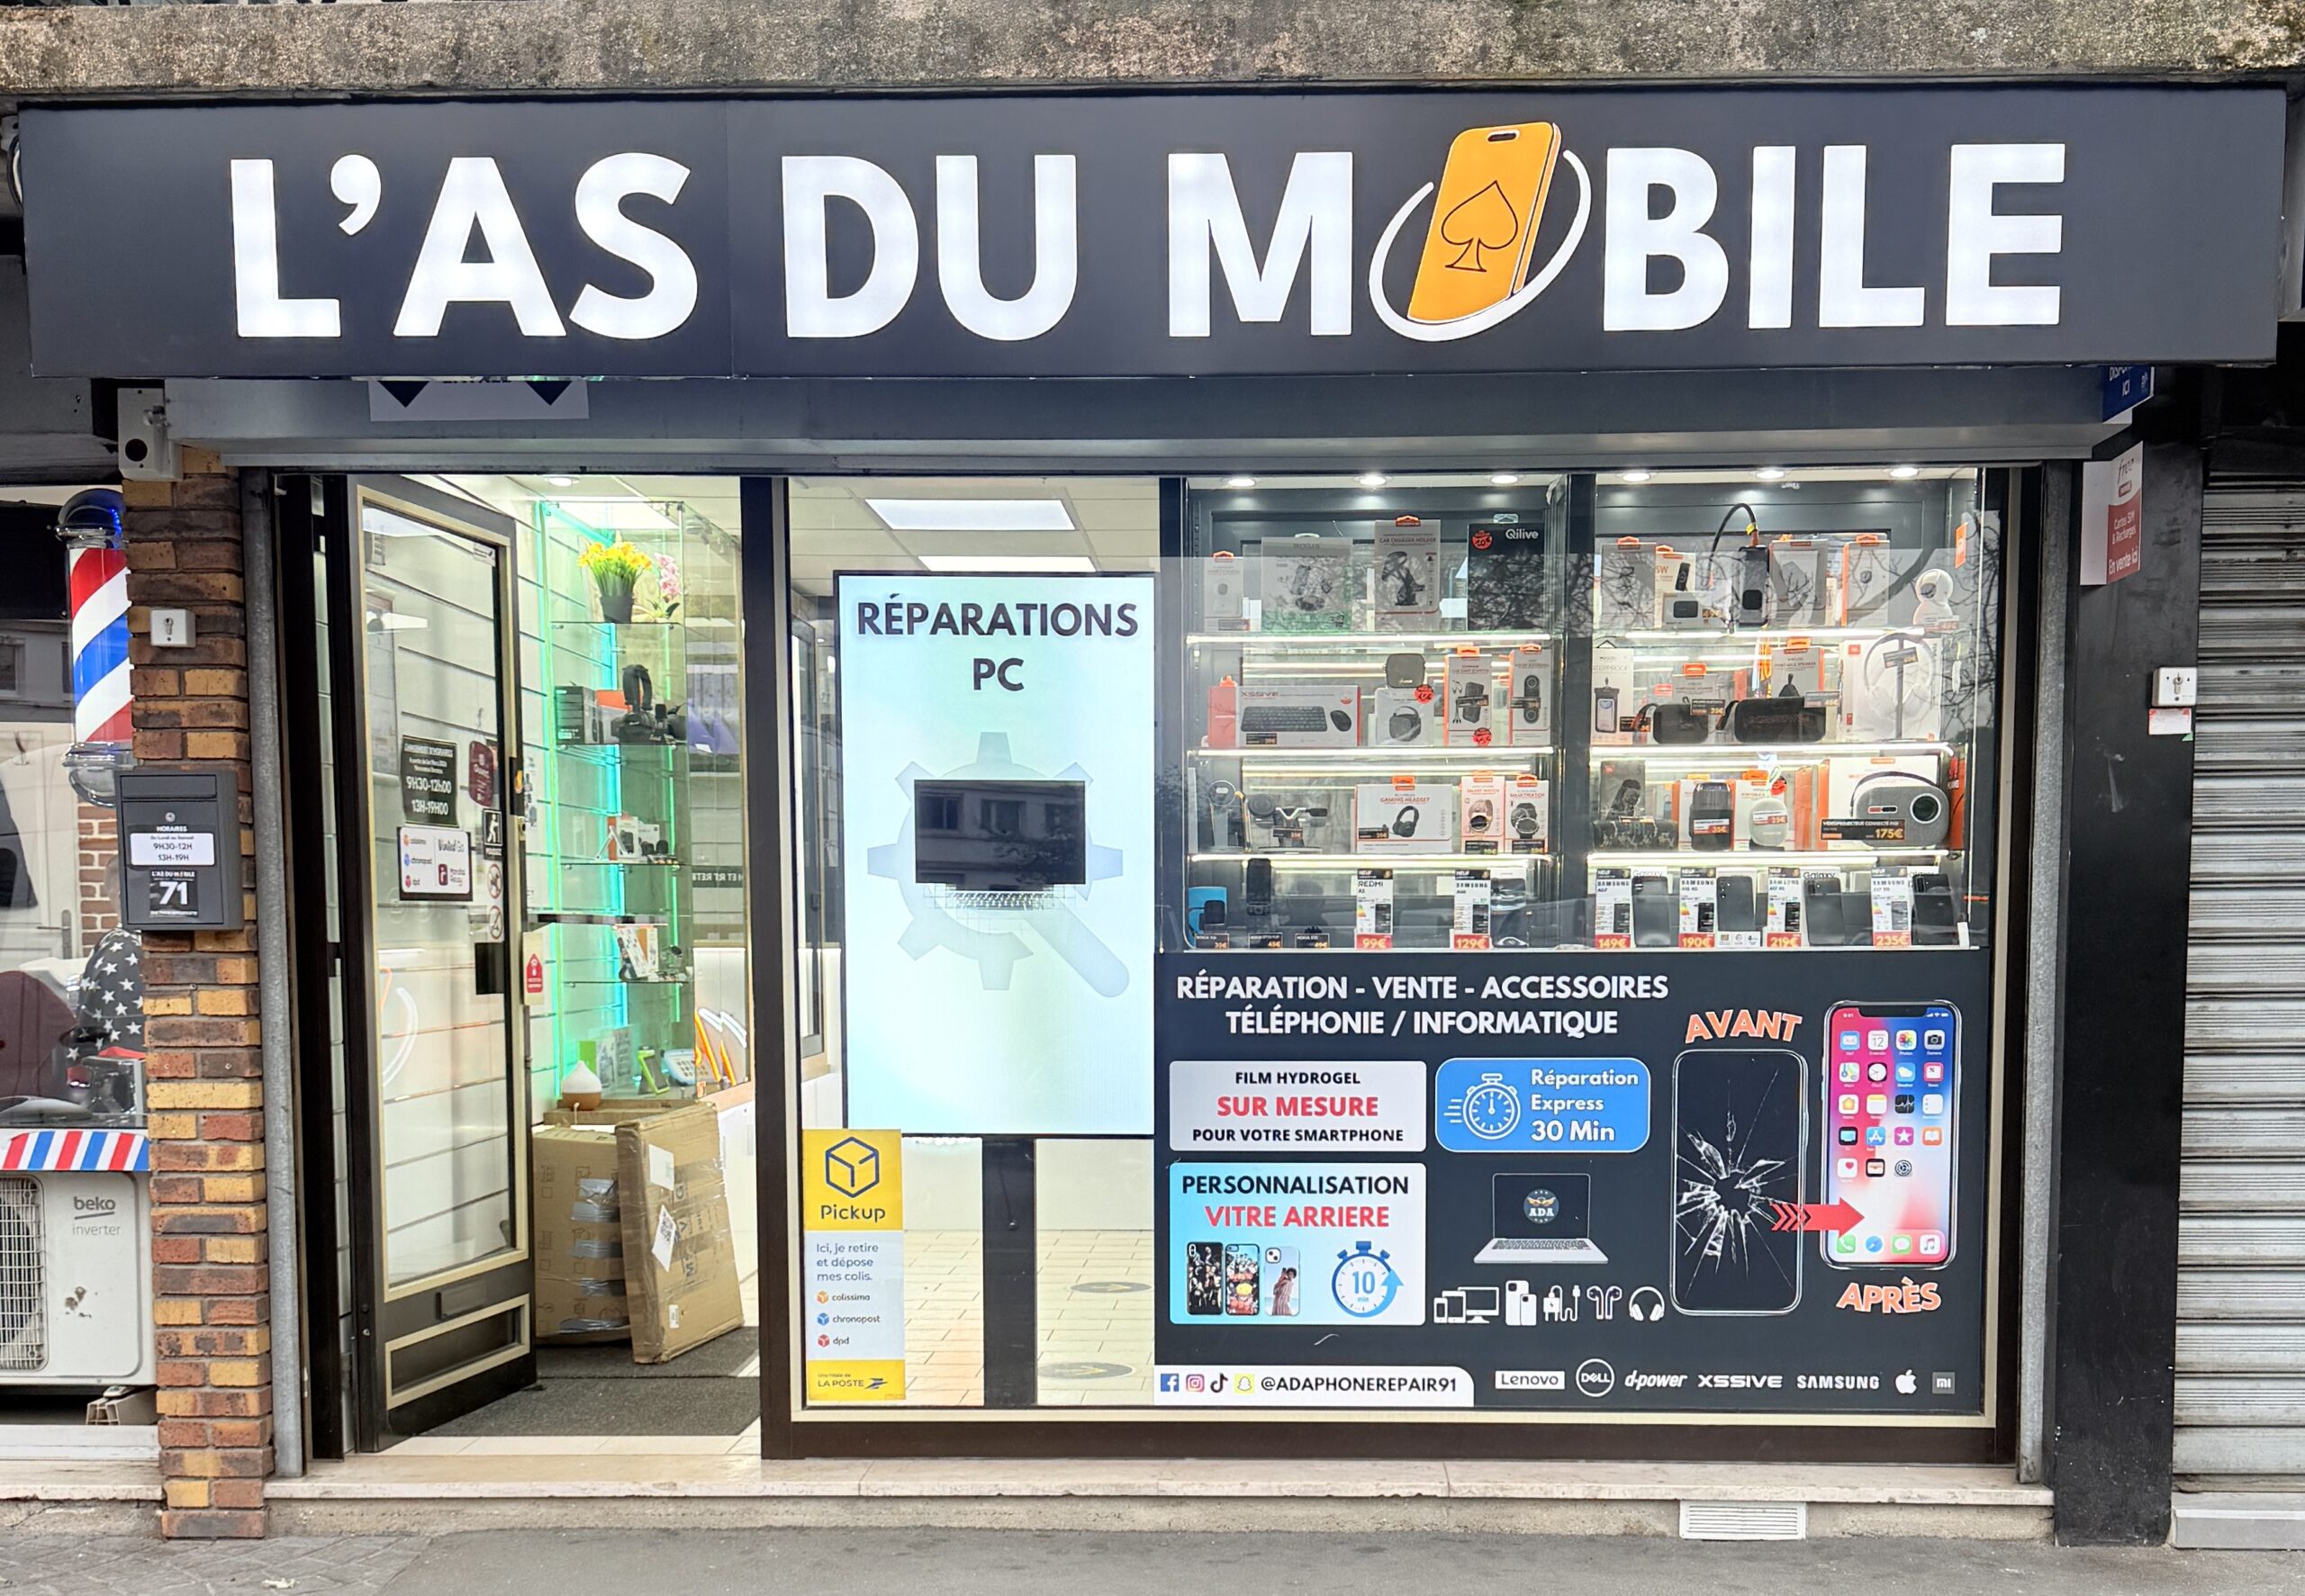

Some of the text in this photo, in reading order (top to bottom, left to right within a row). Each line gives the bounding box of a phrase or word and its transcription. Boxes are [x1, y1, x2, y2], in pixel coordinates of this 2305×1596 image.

[230, 152, 700, 340] L'AS
[781, 155, 1080, 342] DU
[1505, 528, 1540, 540] Qilive
[857, 592, 1139, 637] RÉPARATIONS
[972, 657, 1025, 691] PC
[1875, 828, 1904, 839] 175€
[153, 843, 193, 851] 9H30-12H
[158, 853, 189, 861] 13H-19H
[1803, 871, 1836, 879] Galaxy
[158, 881, 188, 906] 71
[1362, 938, 1387, 949] 99€
[1456, 938, 1487, 949] 129€
[1598, 938, 1627, 949] 149€
[1682, 937, 1712, 948] 190€
[1770, 936, 1799, 948] 219€
[1876, 935, 1909, 947] 235€
[1176, 969, 1348, 1000] RÉPARATION
[1371, 977, 1457, 1000] VENTE
[1480, 976, 1669, 1000] ACCESSOIRES
[1225, 1005, 1384, 1035] TÉLÉPHONIE
[1414, 1010, 1618, 1038] INFORMATIQUE
[1685, 1009, 1803, 1044] AVANT
[1872, 1037, 1884, 1048] 12
[1234, 1071, 1360, 1085] FILM HYDROGEL
[1531, 1069, 1639, 1090] Réparation
[1216, 1096, 1379, 1117] SUR MESURE
[1531, 1096, 1604, 1115] Express
[1192, 1128, 1405, 1142] POUR VOTRE SMARTPHONE
[1531, 1121, 1616, 1142] 30 Min
[1182, 1176, 1410, 1195] PERSONNALISATION
[73, 1196, 116, 1211] beko
[820, 1204, 886, 1223] Pickup
[1205, 1205, 1389, 1228] VITRE ARRIERE
[1529, 1207, 1555, 1217] ADA
[72, 1224, 121, 1236] inverter
[816, 1242, 879, 1255] Ici, je retire
[816, 1257, 873, 1268] et dépose
[817, 1271, 872, 1282] mes colis.
[1351, 1270, 1377, 1295] 10
[832, 1293, 871, 1302] colissimo
[1836, 1276, 1941, 1313] APRÈS
[832, 1314, 881, 1325] chronopost
[832, 1337, 850, 1346] dpd
[818, 1379, 864, 1387] LA POSTE
[1261, 1376, 1457, 1393] @ADAPHONEREPAIR91
[1501, 1374, 1559, 1387] Lenovo
[1580, 1374, 1612, 1384] DELL
[1698, 1375, 1783, 1389] XSSIVE
[1796, 1375, 1880, 1390] SAMSUNG
